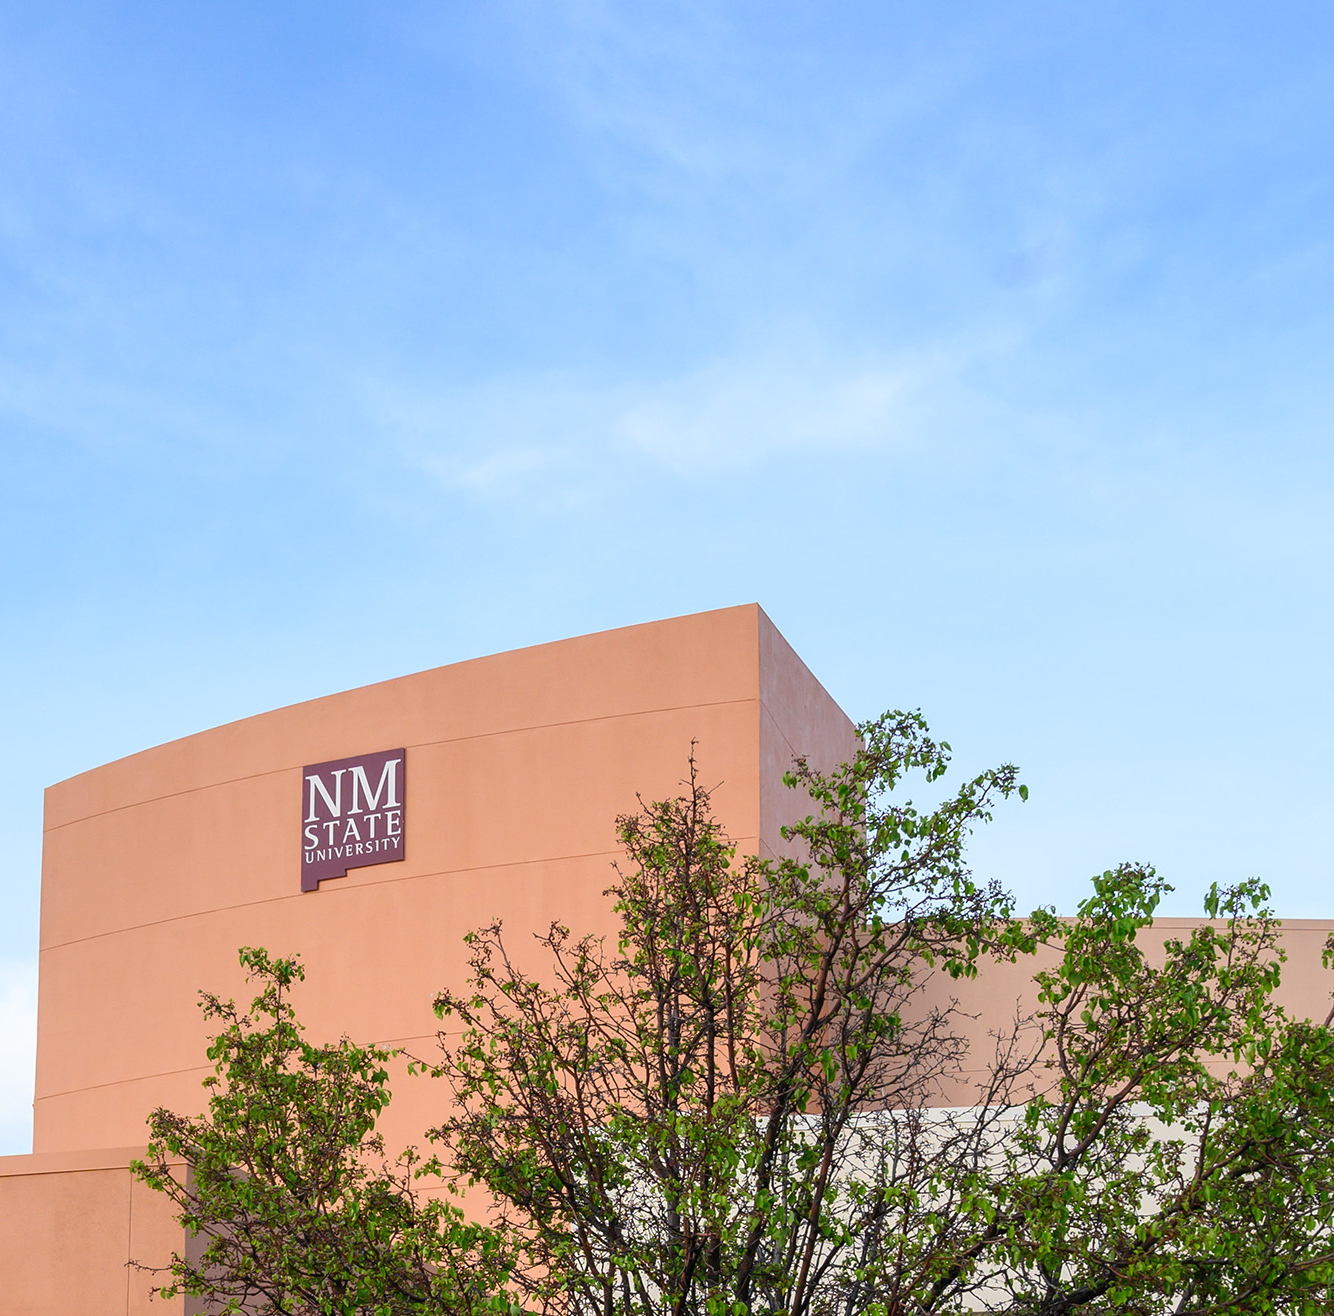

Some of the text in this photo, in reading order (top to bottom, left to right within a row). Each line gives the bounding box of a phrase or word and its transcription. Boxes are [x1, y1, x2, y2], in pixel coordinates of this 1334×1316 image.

[304, 758, 402, 823] NM
[304, 809, 402, 850] STATE
[305, 836, 401, 864] UNIVERSITY
